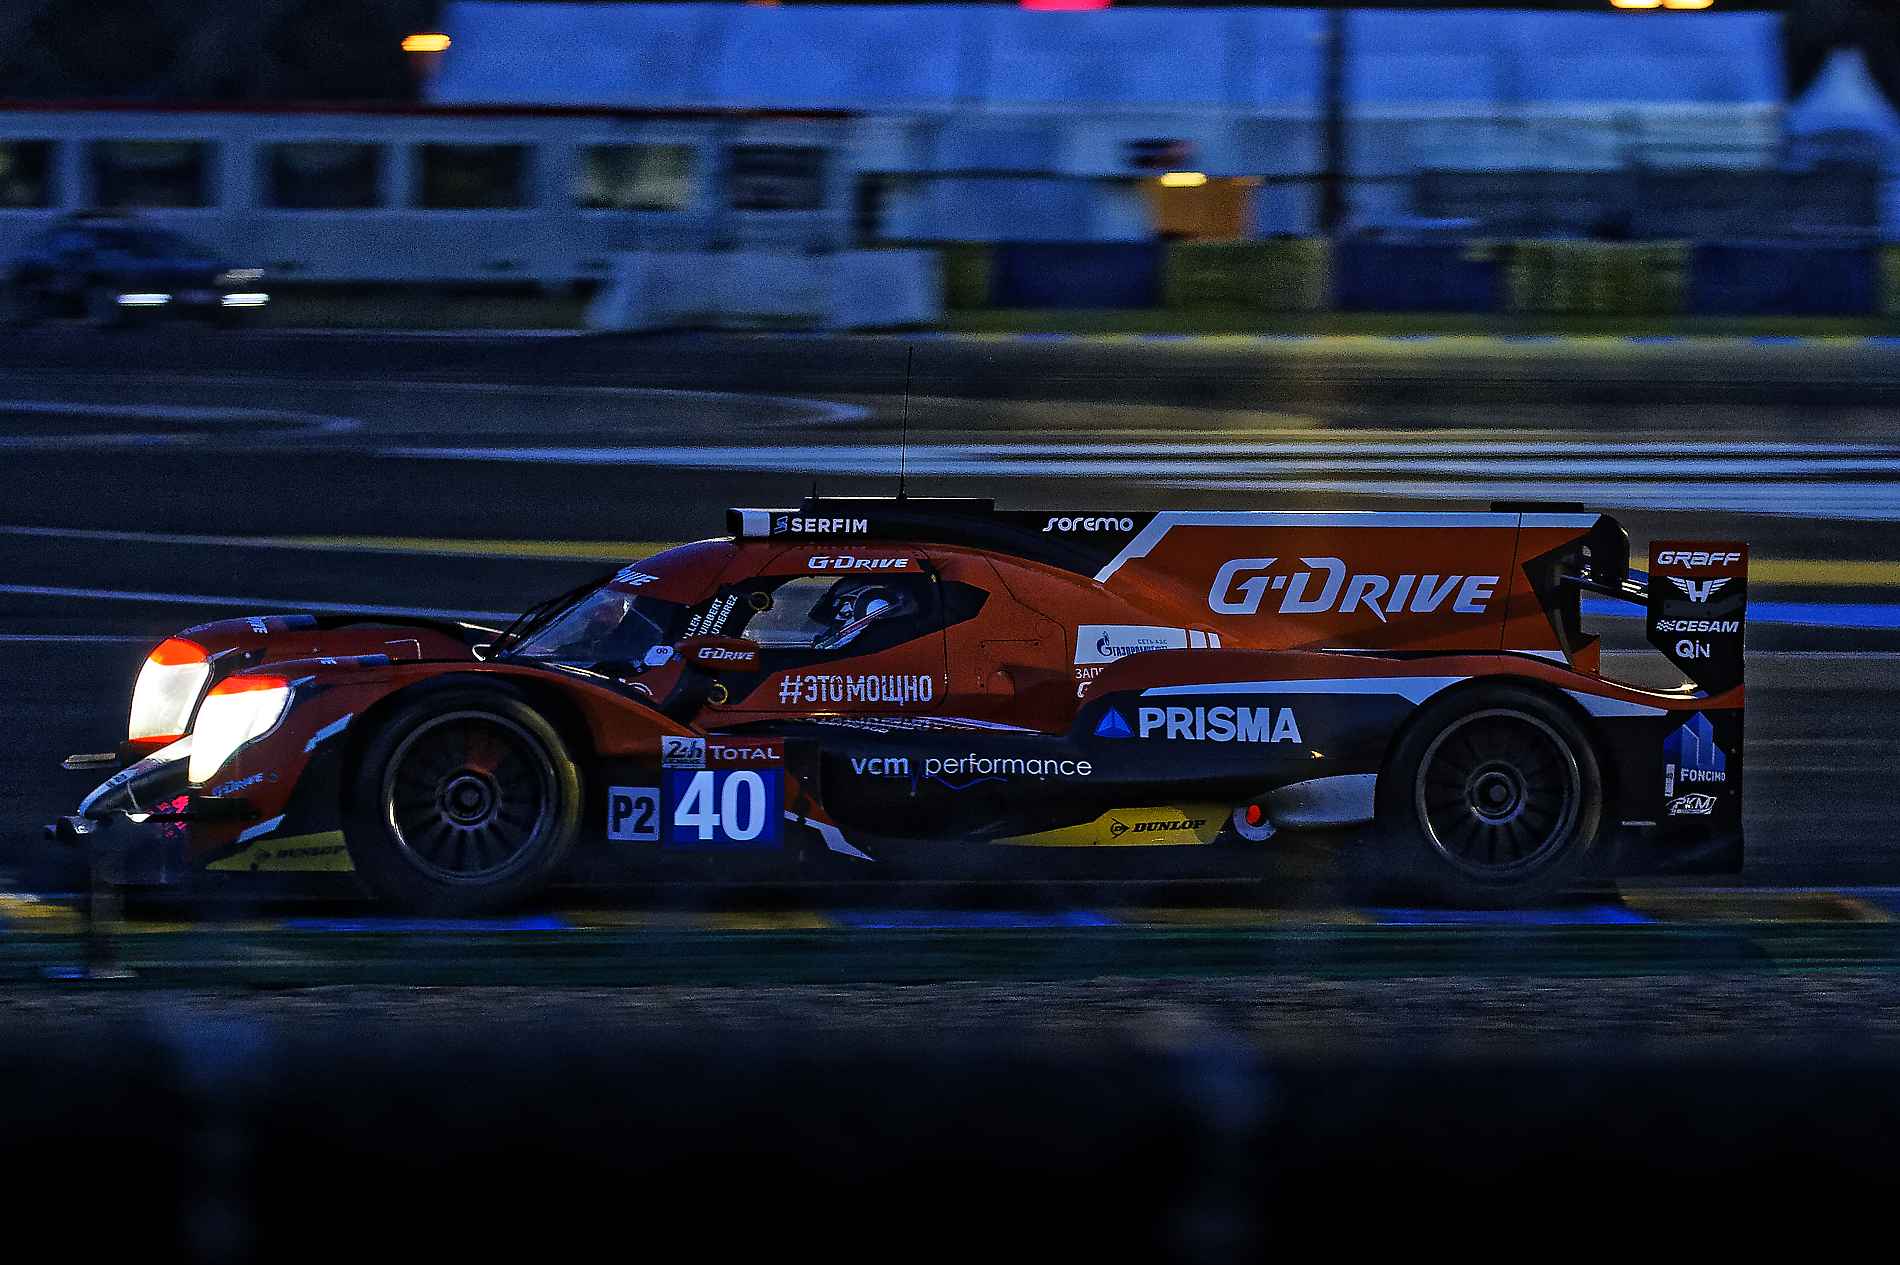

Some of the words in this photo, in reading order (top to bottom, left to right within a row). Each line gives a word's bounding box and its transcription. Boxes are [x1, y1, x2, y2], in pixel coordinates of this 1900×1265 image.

[791, 517, 868, 533] SERFIM
[1657, 551, 1741, 569] GRAFF
[1208, 557, 1500, 623] G-DRIVE
[682, 614, 702, 639] LLEN
[697, 598, 723, 636] UIBBERT
[1675, 620, 1740, 633] CESAM
[1138, 706, 1303, 744] PRISMA
[709, 745, 781, 760] TOTAL
[850, 757, 909, 775] vcm
[925, 753, 1093, 779] performance
[611, 795, 656, 834] P2
[673, 770, 766, 841] 40
[1131, 820, 1206, 832] DUNLOP
